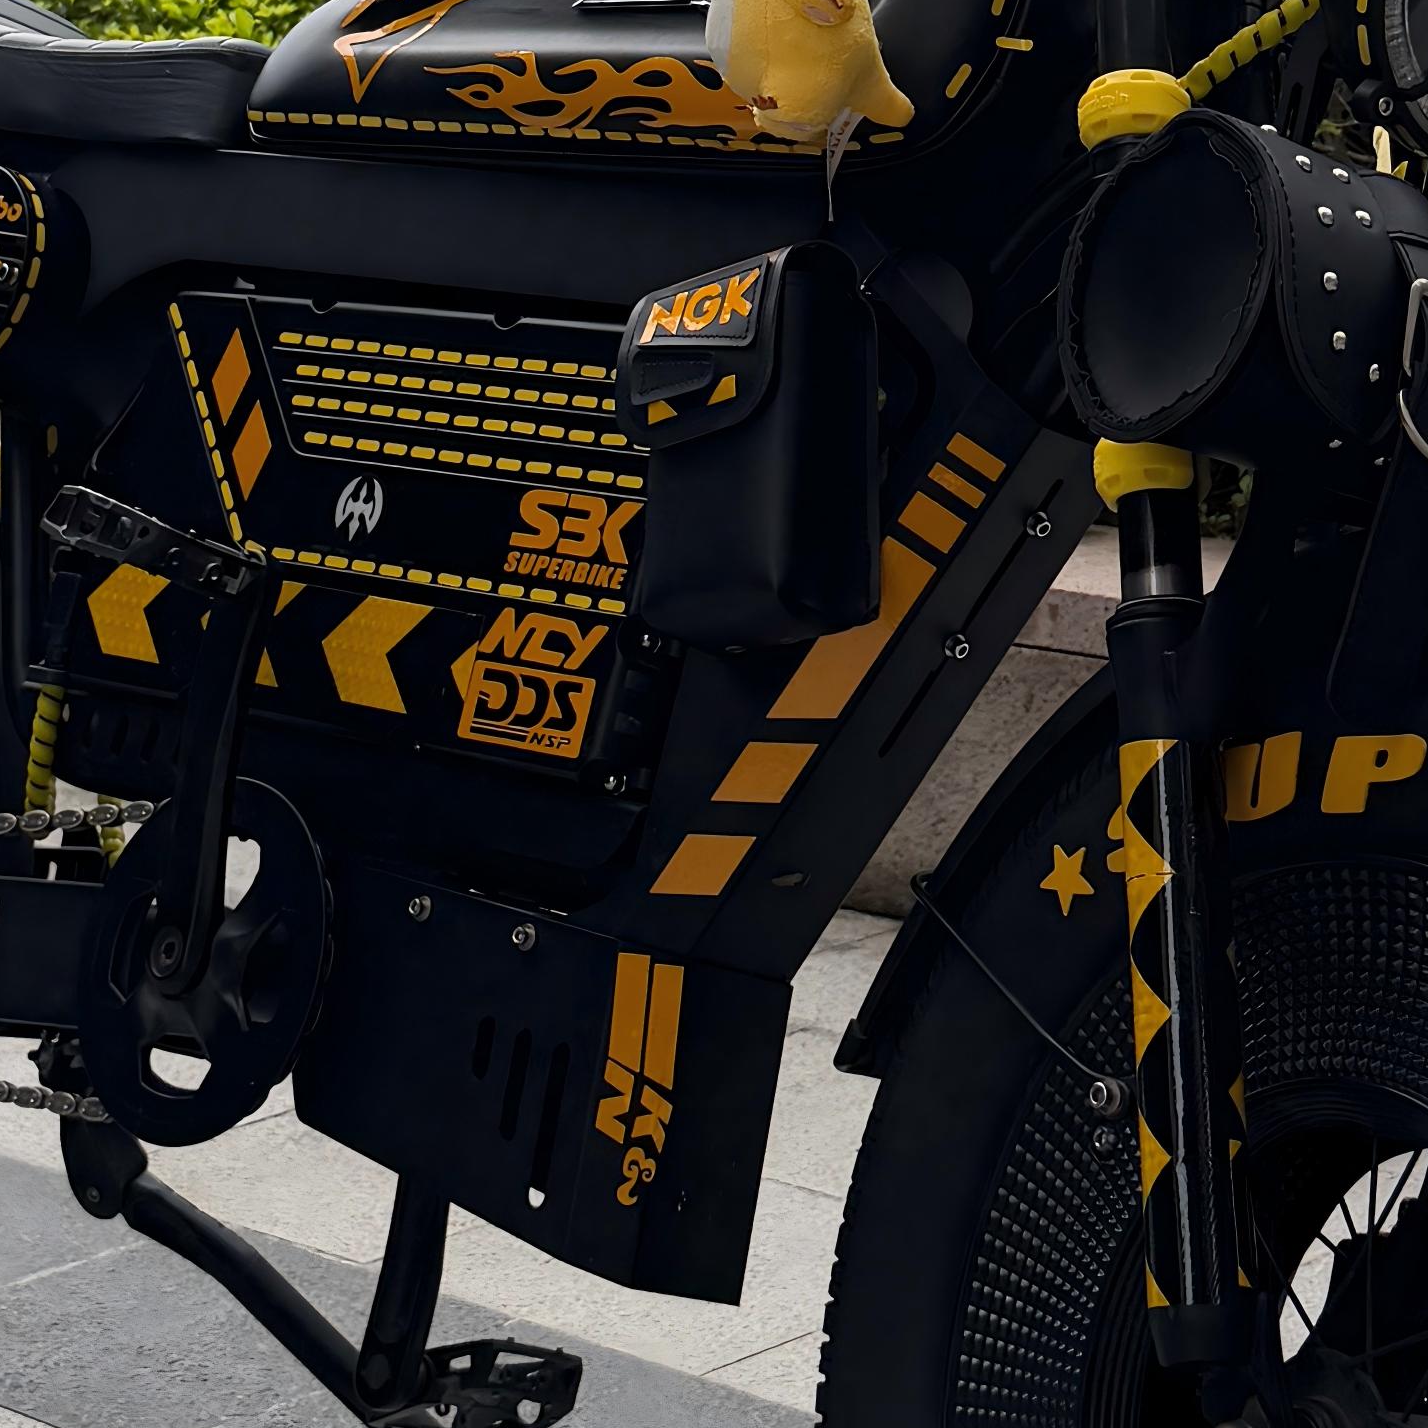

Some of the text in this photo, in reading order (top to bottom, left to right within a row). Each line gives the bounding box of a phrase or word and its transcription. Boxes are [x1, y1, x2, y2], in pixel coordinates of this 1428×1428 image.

[639, 267, 762, 345] NGK
[509, 489, 645, 565] SBK
[503, 551, 628, 590] SUPERBIKE
[529, 732, 572, 749] NSP
